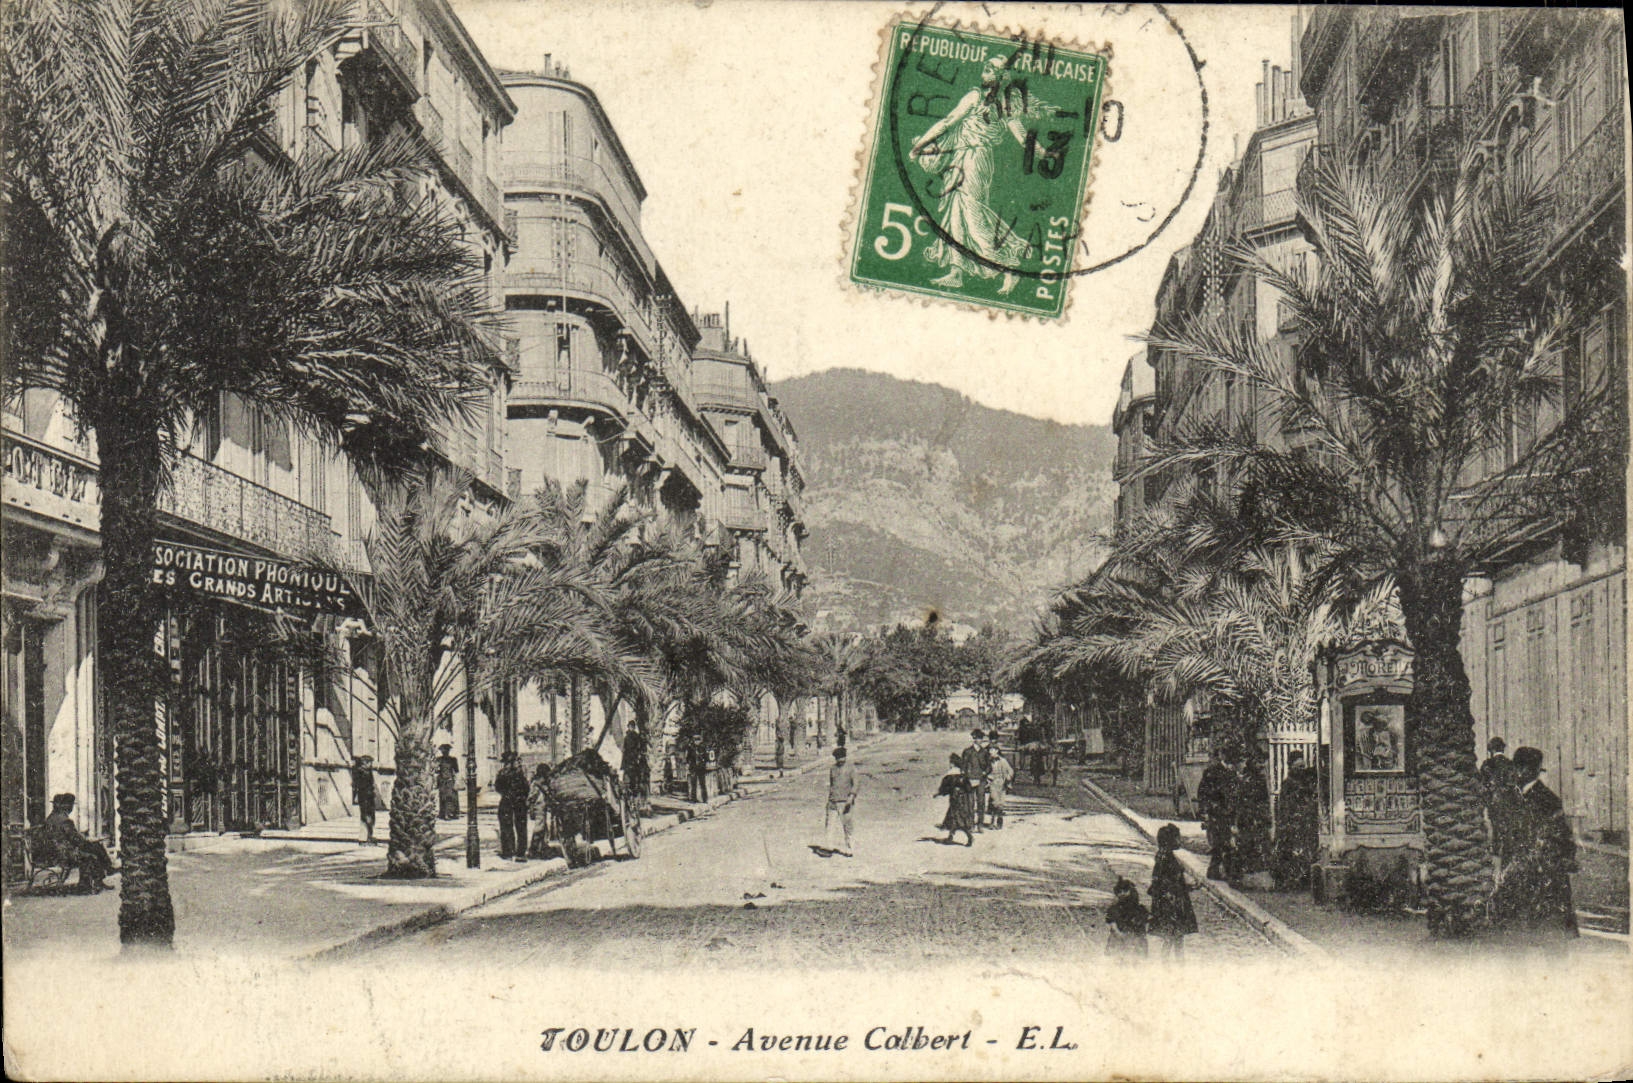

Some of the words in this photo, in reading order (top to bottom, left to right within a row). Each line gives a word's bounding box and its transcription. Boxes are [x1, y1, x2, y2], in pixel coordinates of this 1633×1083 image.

[1036, 215, 1069, 300] POSTES
[152, 546, 249, 578] SOCIATION
[152, 569, 176, 586] ES
[190, 571, 256, 598] GRANDS
[261, 582, 346, 612] ARTIS
